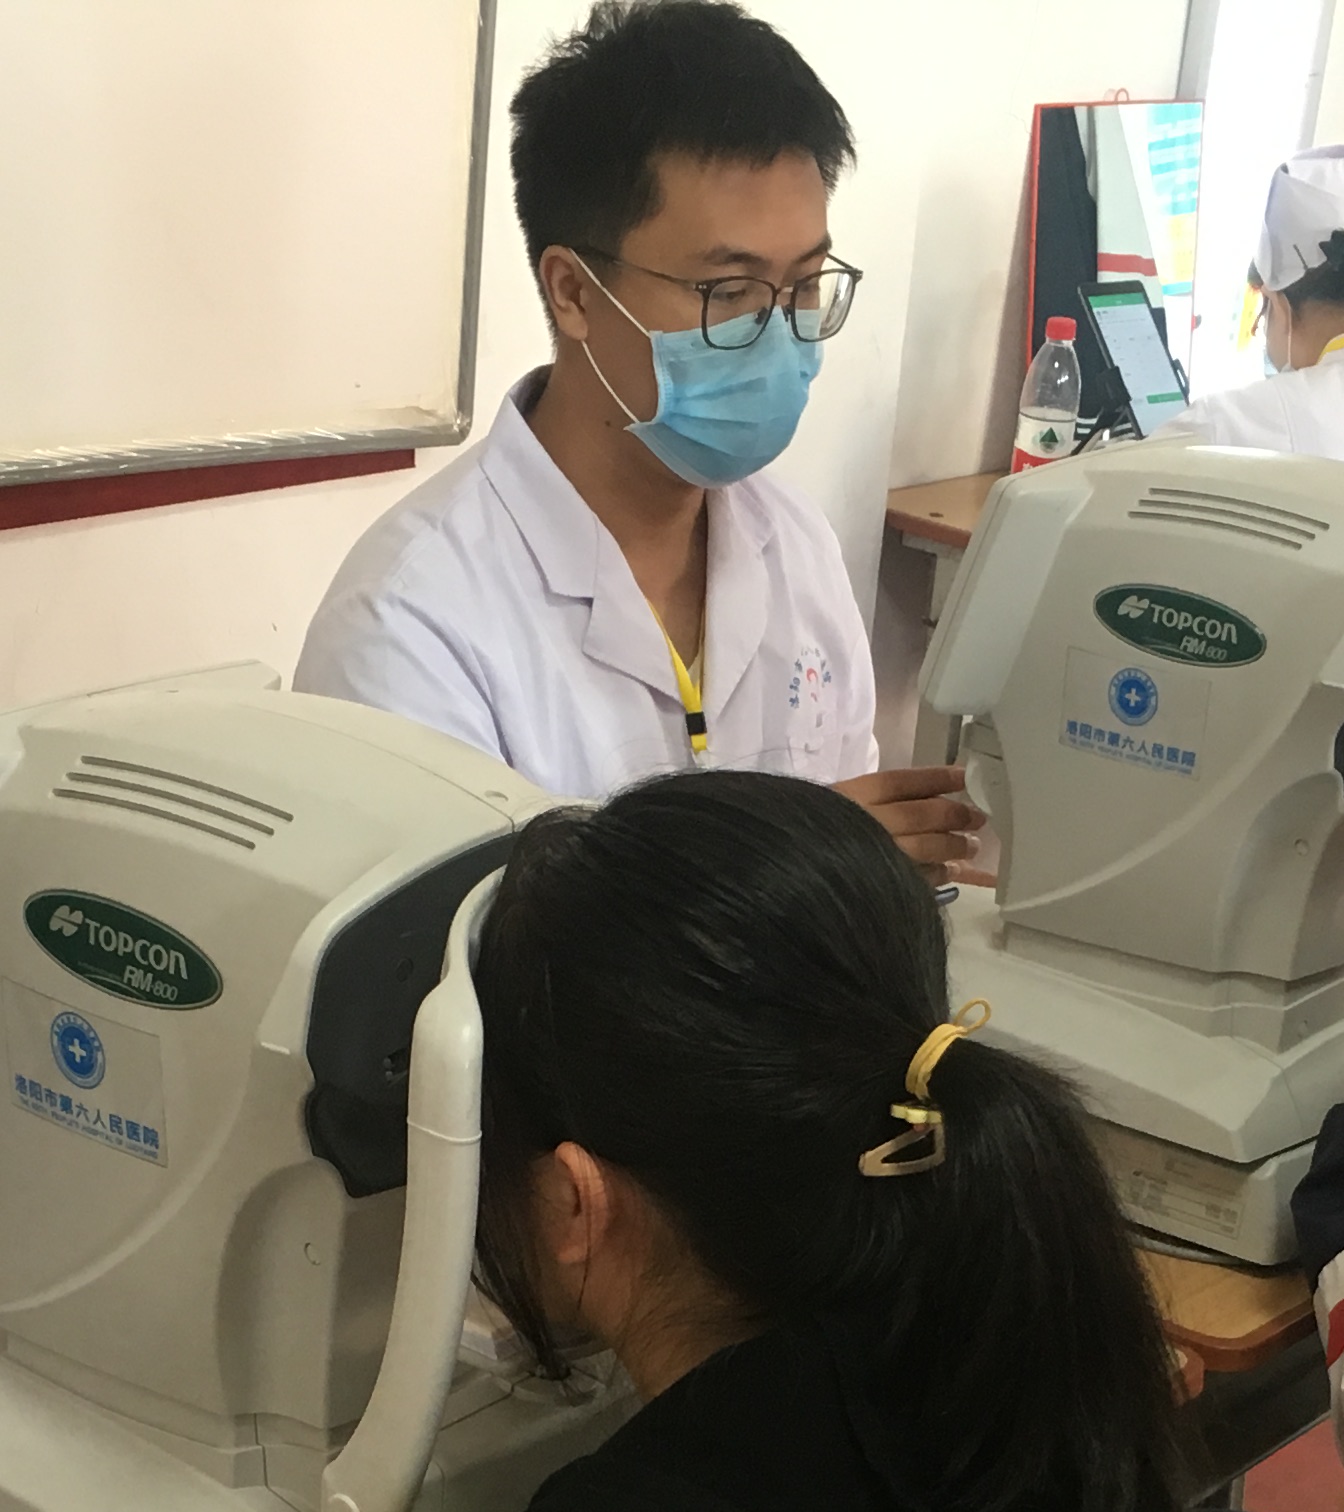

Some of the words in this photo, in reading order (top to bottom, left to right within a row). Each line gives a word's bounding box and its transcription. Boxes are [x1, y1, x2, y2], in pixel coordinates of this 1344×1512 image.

[1150, 603, 1238, 644] TOPCON
[1065, 719, 1196, 768] 洛阳市第六人民医院
[84, 918, 188, 980] TOPCON
[123, 964, 178, 1001] RM-800
[14, 1073, 160, 1150] 洛阳市第六人民医院
